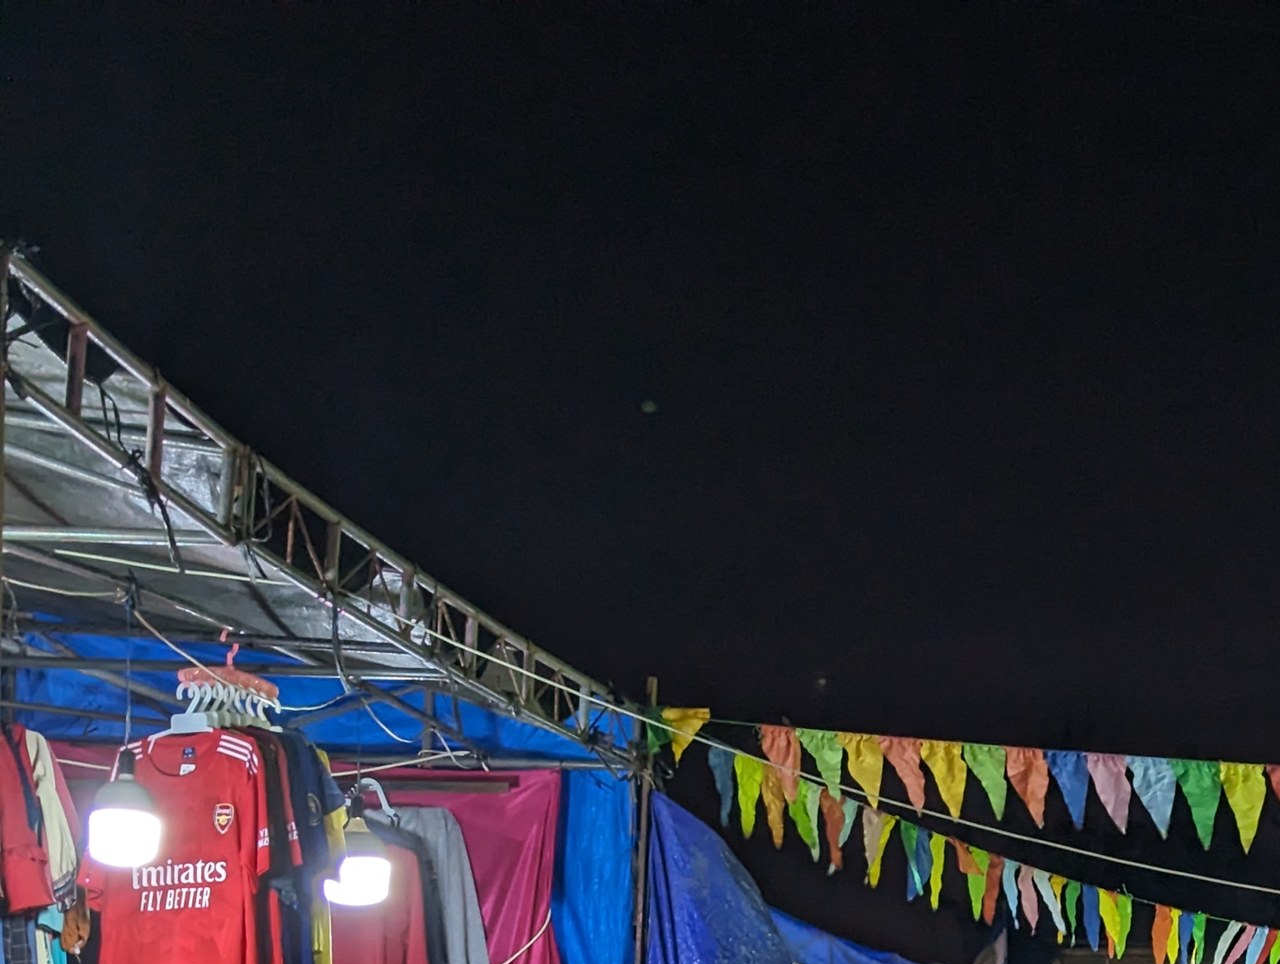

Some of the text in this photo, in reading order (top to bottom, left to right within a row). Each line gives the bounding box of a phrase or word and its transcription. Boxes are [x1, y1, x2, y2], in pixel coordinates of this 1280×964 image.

[131, 858, 228, 890] Emirates
[140, 886, 211, 912] FLY BETTER
